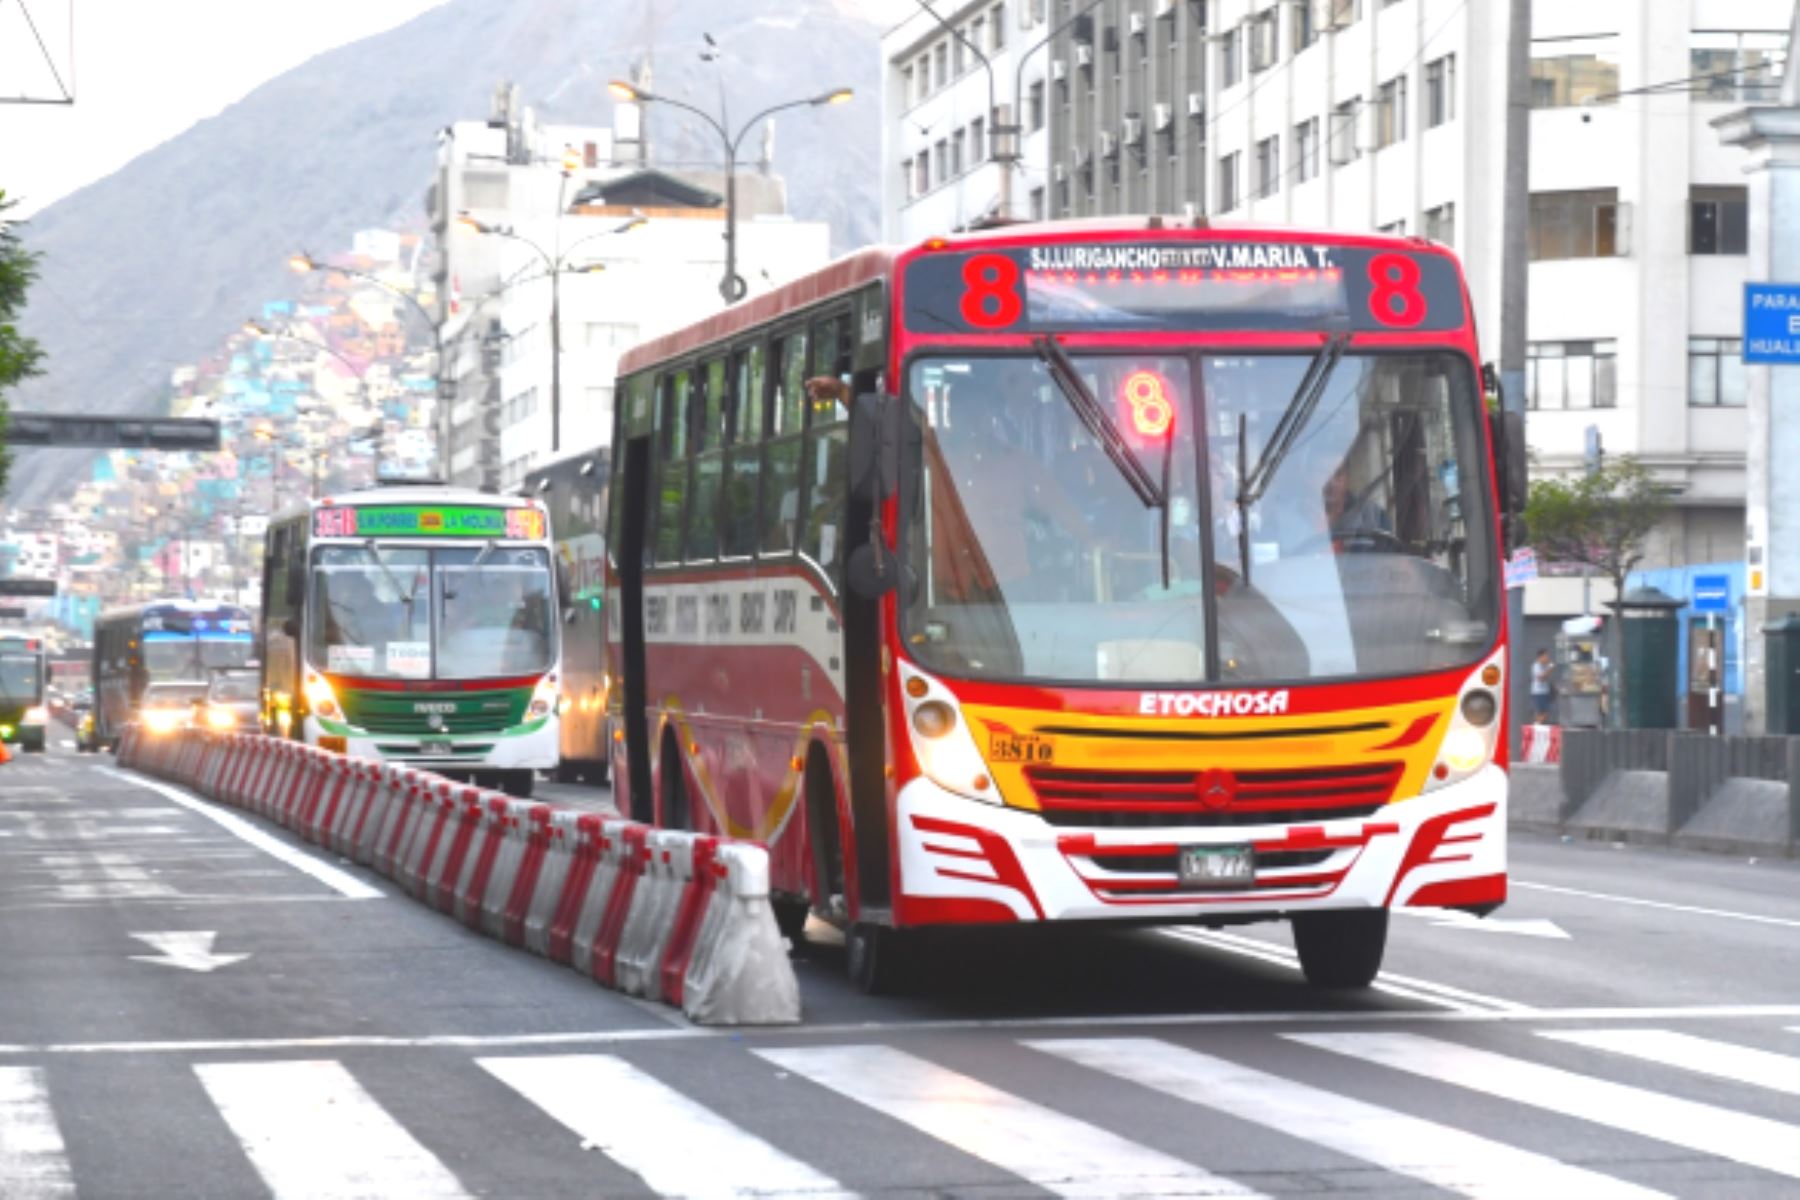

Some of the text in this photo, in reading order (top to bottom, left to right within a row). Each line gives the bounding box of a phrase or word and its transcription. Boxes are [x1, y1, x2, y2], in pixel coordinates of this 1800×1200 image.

[1211, 245, 1309, 268] V.MARIA
[1312, 245, 1334, 268] T.
[959, 253, 1022, 329] 8
[1366, 252, 1427, 328] 8
[1124, 372, 1172, 435] 8
[1139, 689, 1290, 717] ETOCHOSA
